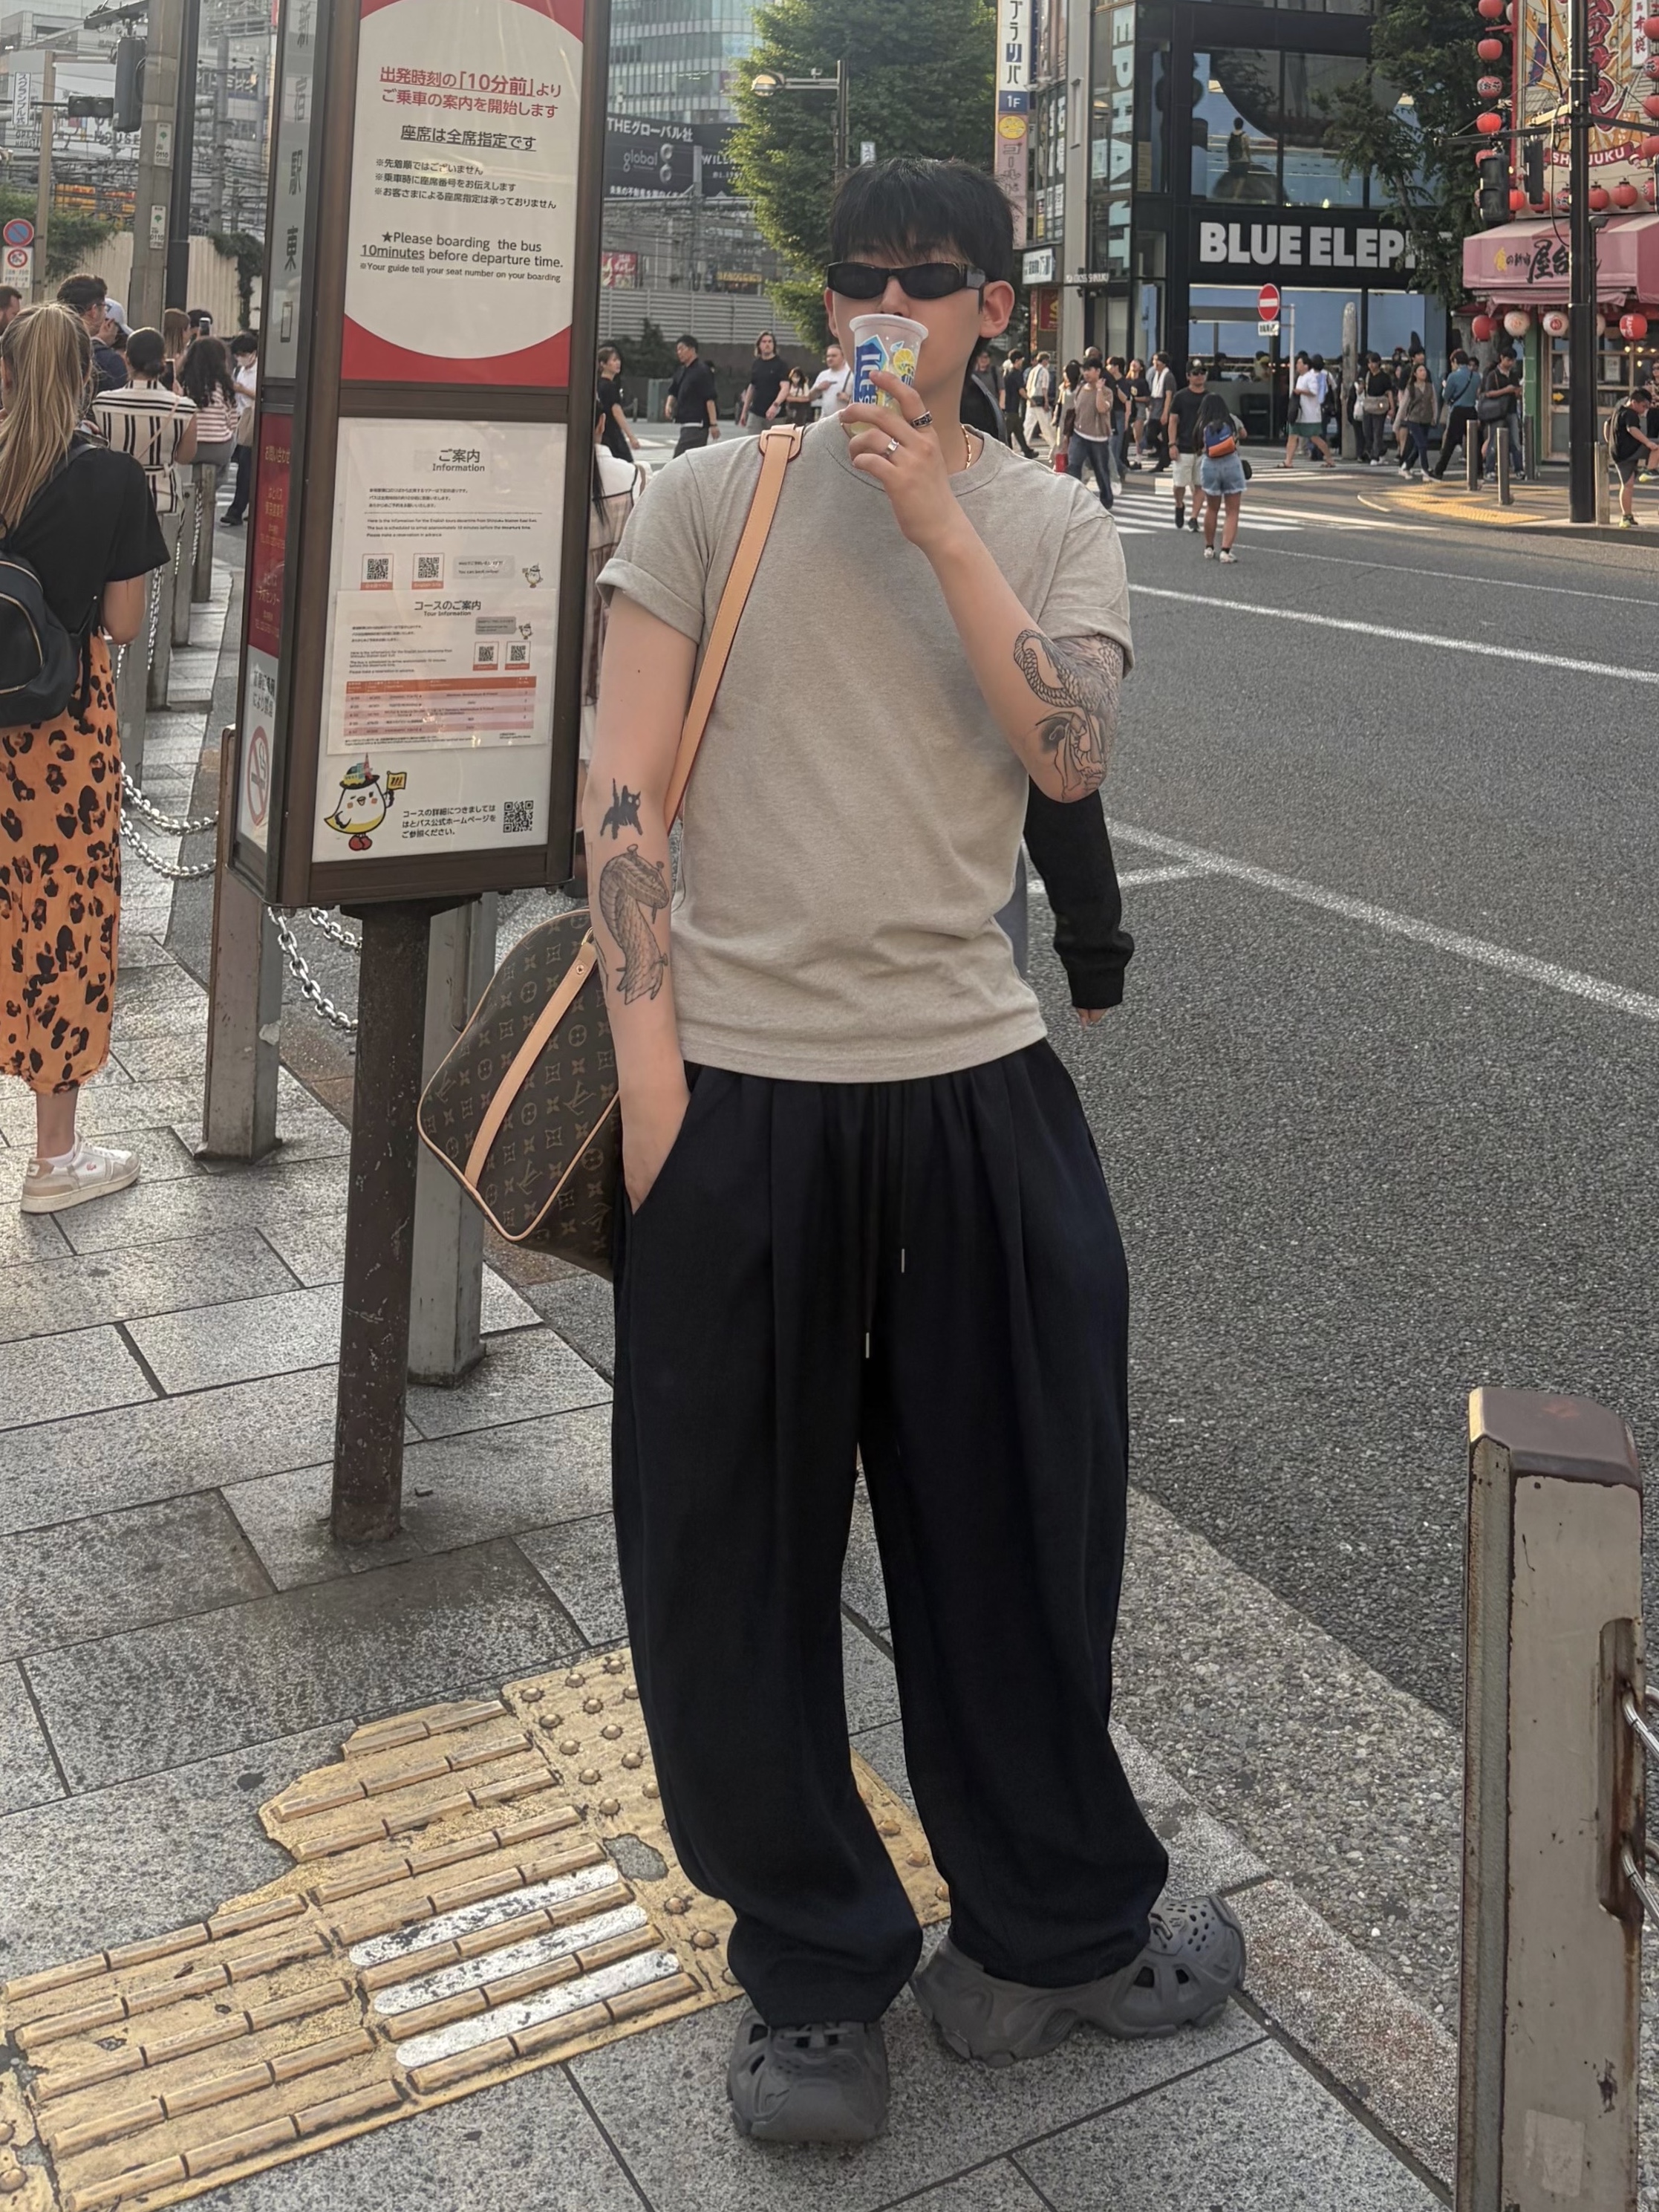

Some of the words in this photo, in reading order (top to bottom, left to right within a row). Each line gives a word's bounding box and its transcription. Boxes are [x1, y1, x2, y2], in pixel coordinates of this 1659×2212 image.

[379, 66, 561, 97] 出発時刻の「10分前」より
[382, 88, 558, 118] ご乗車の案内を開始します
[1007, 95, 1021, 108] 1F
[400, 124, 537, 151] 座席は全席指定です
[607, 117, 694, 143] THEグローバル社
[623, 149, 658, 172] global
[1552, 146, 1625, 165] SHJUKU
[437, 234, 490, 251] boarding
[498, 238, 517, 251] the
[521, 240, 541, 253] bus
[1199, 221, 1302, 266] BLUE
[361, 244, 426, 260] 10minutes
[428, 249, 469, 261] before
[472, 251, 531, 266] departure
[534, 256, 564, 268] time.
[387, 264, 409, 274] guide
[411, 265, 425, 273] tell
[426, 267, 444, 276] your
[464, 269, 494, 278] number
[508, 272, 526, 281] your
[527, 272, 561, 283] boarding
[859, 354, 881, 392] ICE
[439, 449, 480, 463] ご案内
[432, 463, 485, 472] Information
[414, 600, 481, 611] コースのご案内
[402, 804, 496, 818] コースの詳細につきましては
[402, 814, 496, 828] はとバス公式ホームページを
[402, 829, 456, 839] ご参照ください。
